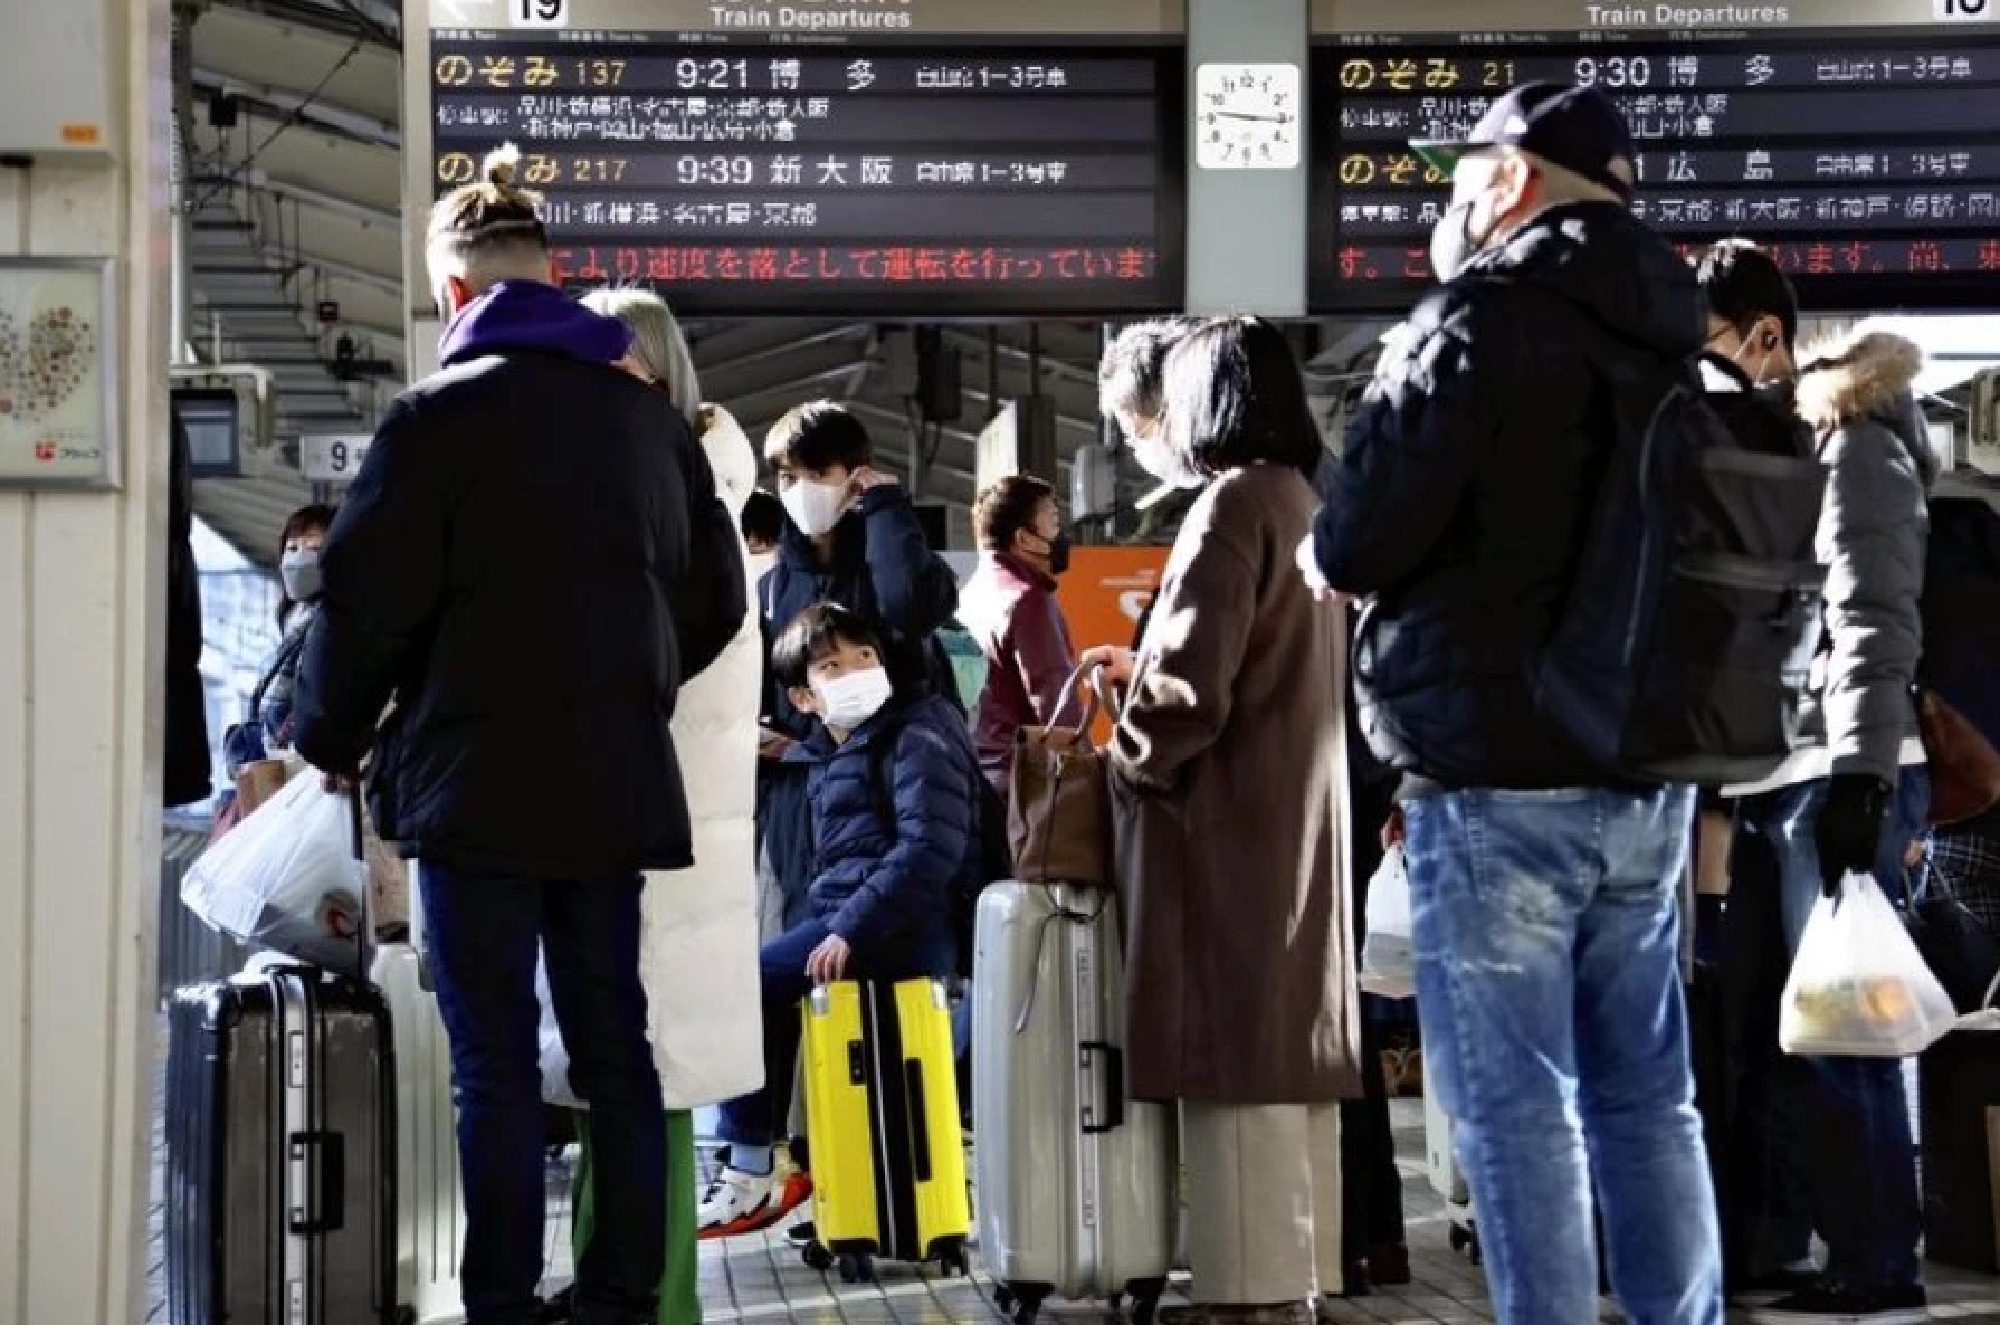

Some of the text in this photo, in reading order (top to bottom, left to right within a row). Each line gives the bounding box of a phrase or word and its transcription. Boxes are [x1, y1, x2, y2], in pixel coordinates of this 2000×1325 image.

[710, 7, 912, 31] Train Departures
[1587, 5, 1789, 29] Train Departures
[436, 56, 559, 87] のぞみ
[574, 60, 627, 86] 137
[676, 58, 748, 88] 9:21
[1340, 57, 1460, 90] のぞみ
[1482, 62, 1516, 87] 21
[1574, 56, 1650, 88] 9:30
[437, 152, 561, 182] のみ
[573, 160, 627, 181] 217
[676, 154, 752, 184] 9:39
[768, 153, 893, 184] 新大阪
[546, 247, 1157, 280] により速度を落として運転を行っていま
[331, 441, 347, 472] 9
